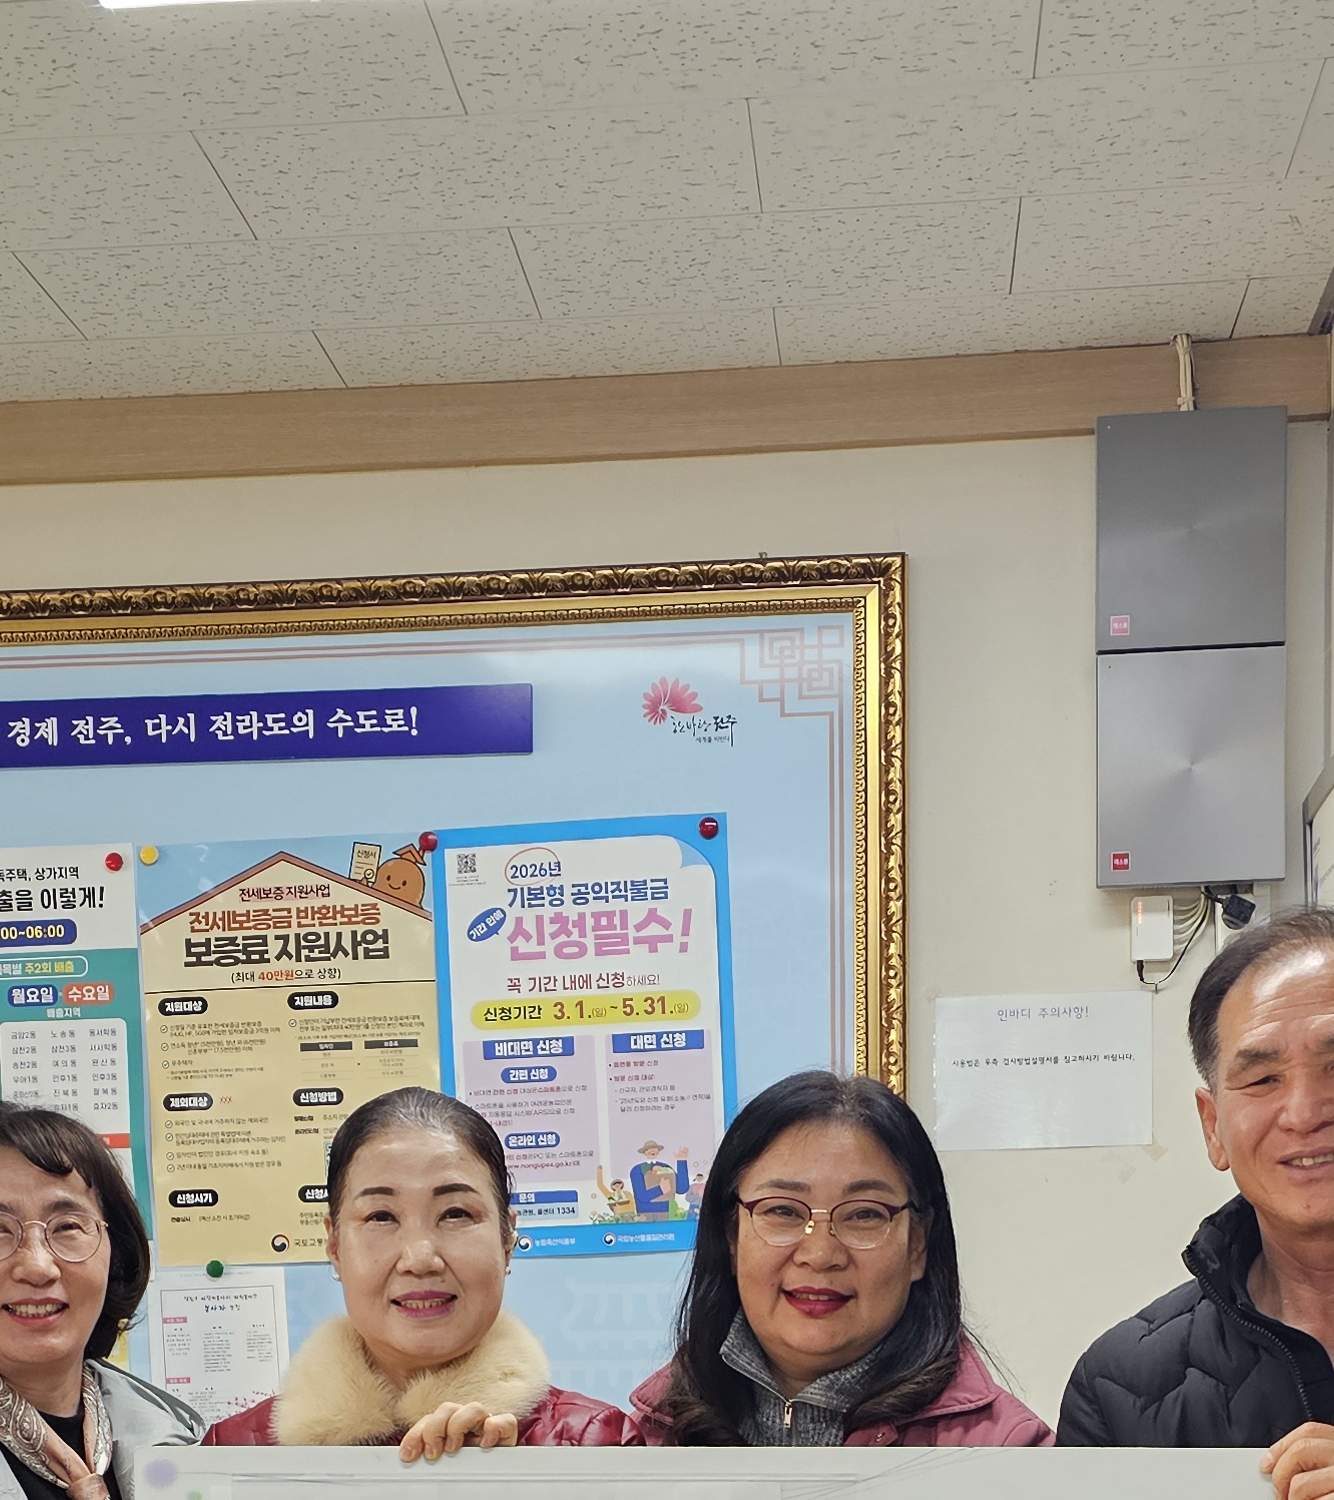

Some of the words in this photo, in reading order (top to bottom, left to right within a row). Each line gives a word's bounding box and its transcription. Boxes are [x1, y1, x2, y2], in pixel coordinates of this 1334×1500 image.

[7, 716, 58, 747] 경제
[70, 715, 132, 746] 전주,
[144, 713, 196, 743] 다시
[208, 708, 314, 741] 전라도의
[326, 705, 418, 739] 수도로!
[357, 850, 377, 859] 신청서
[34, 866, 79, 881] 상가지역
[509, 861, 562, 879] 2026년
[40, 886, 105, 911] 이렇게!
[239, 887, 285, 901] 전세보증
[285, 884, 331, 899] 지원사업
[507, 884, 565, 909] 기본형
[570, 877, 669, 907] 공익직불금
[188, 906, 293, 933] 전세보증금
[295, 903, 381, 928] 반환보증
[468, 922, 487, 940] 기간
[485, 908, 505, 927] 안에
[506, 907, 693, 961] 신청필수!
[183, 934, 271, 967] 보증료
[274, 928, 390, 963] 지원사업
[24, 961, 52, 975] 주2회
[54, 960, 74, 973] 배출
[231, 970, 255, 984] (최대
[258, 968, 315, 981] 40만원으로
[316, 967, 341, 980] 상향)
[507, 977, 522, 993] 꼭
[528, 975, 558, 993] 기간
[562, 973, 592, 991] 내에
[11, 986, 53, 1004] 월요일
[68, 984, 110, 1002] 수요일
[293, 995, 333, 1007] 지원내용
[46, 1006, 81, 1018] 배출지역
[165, 1001, 203, 1012] 지원대상
[484, 1005, 543, 1022] 신청기간
[997, 1007, 1031, 1022] 인바디
[1038, 1005, 1089, 1020] 주의사항!
[494, 1041, 533, 1056] 비대면
[536, 1039, 563, 1054] 신청
[630, 1034, 657, 1049] 대면
[660, 1032, 687, 1048] 신청
[509, 1069, 528, 1080] 간편
[530, 1068, 549, 1079] 신청
[170, 1096, 208, 1108] 제외대상
[300, 1091, 337, 1103] 신청방법
[509, 1135, 536, 1147] 온라인
[537, 1134, 556, 1146] 신청
[519, 1193, 535, 1203] 문의
[556, 1206, 576, 1215] 1334
